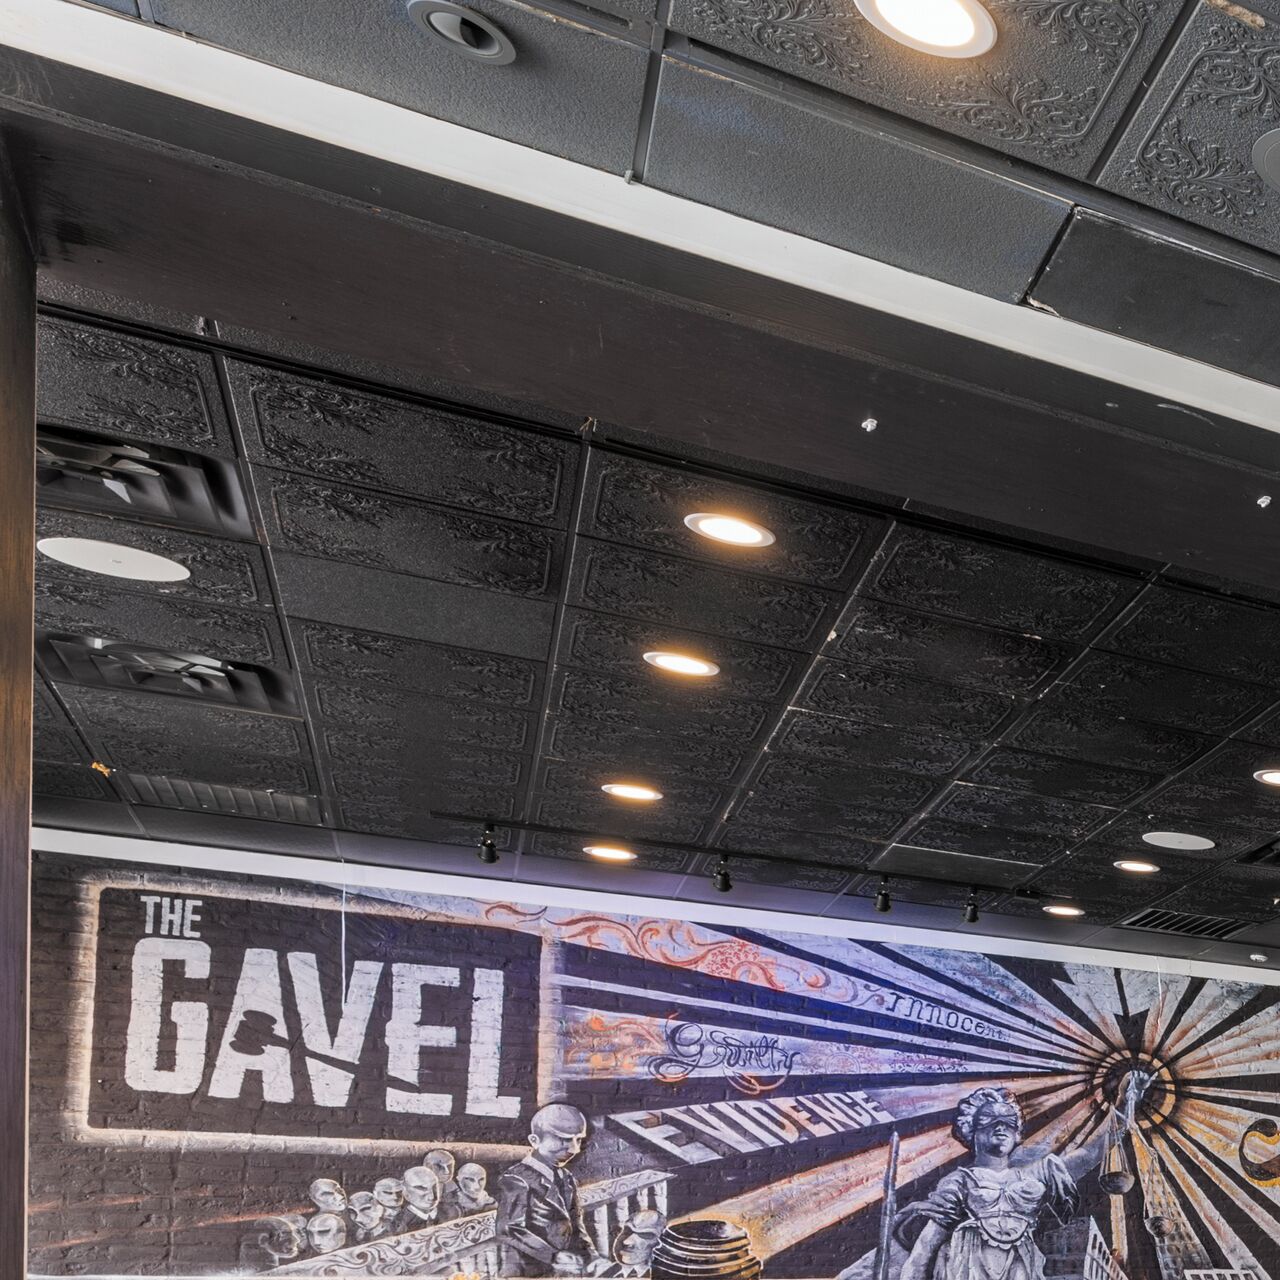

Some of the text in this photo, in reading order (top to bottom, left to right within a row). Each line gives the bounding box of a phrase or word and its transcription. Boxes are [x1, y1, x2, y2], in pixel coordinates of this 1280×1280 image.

[140, 895, 202, 938] THE
[124, 936, 522, 1120] GAVEL
[605, 1089, 898, 1166] EVIDENCE
